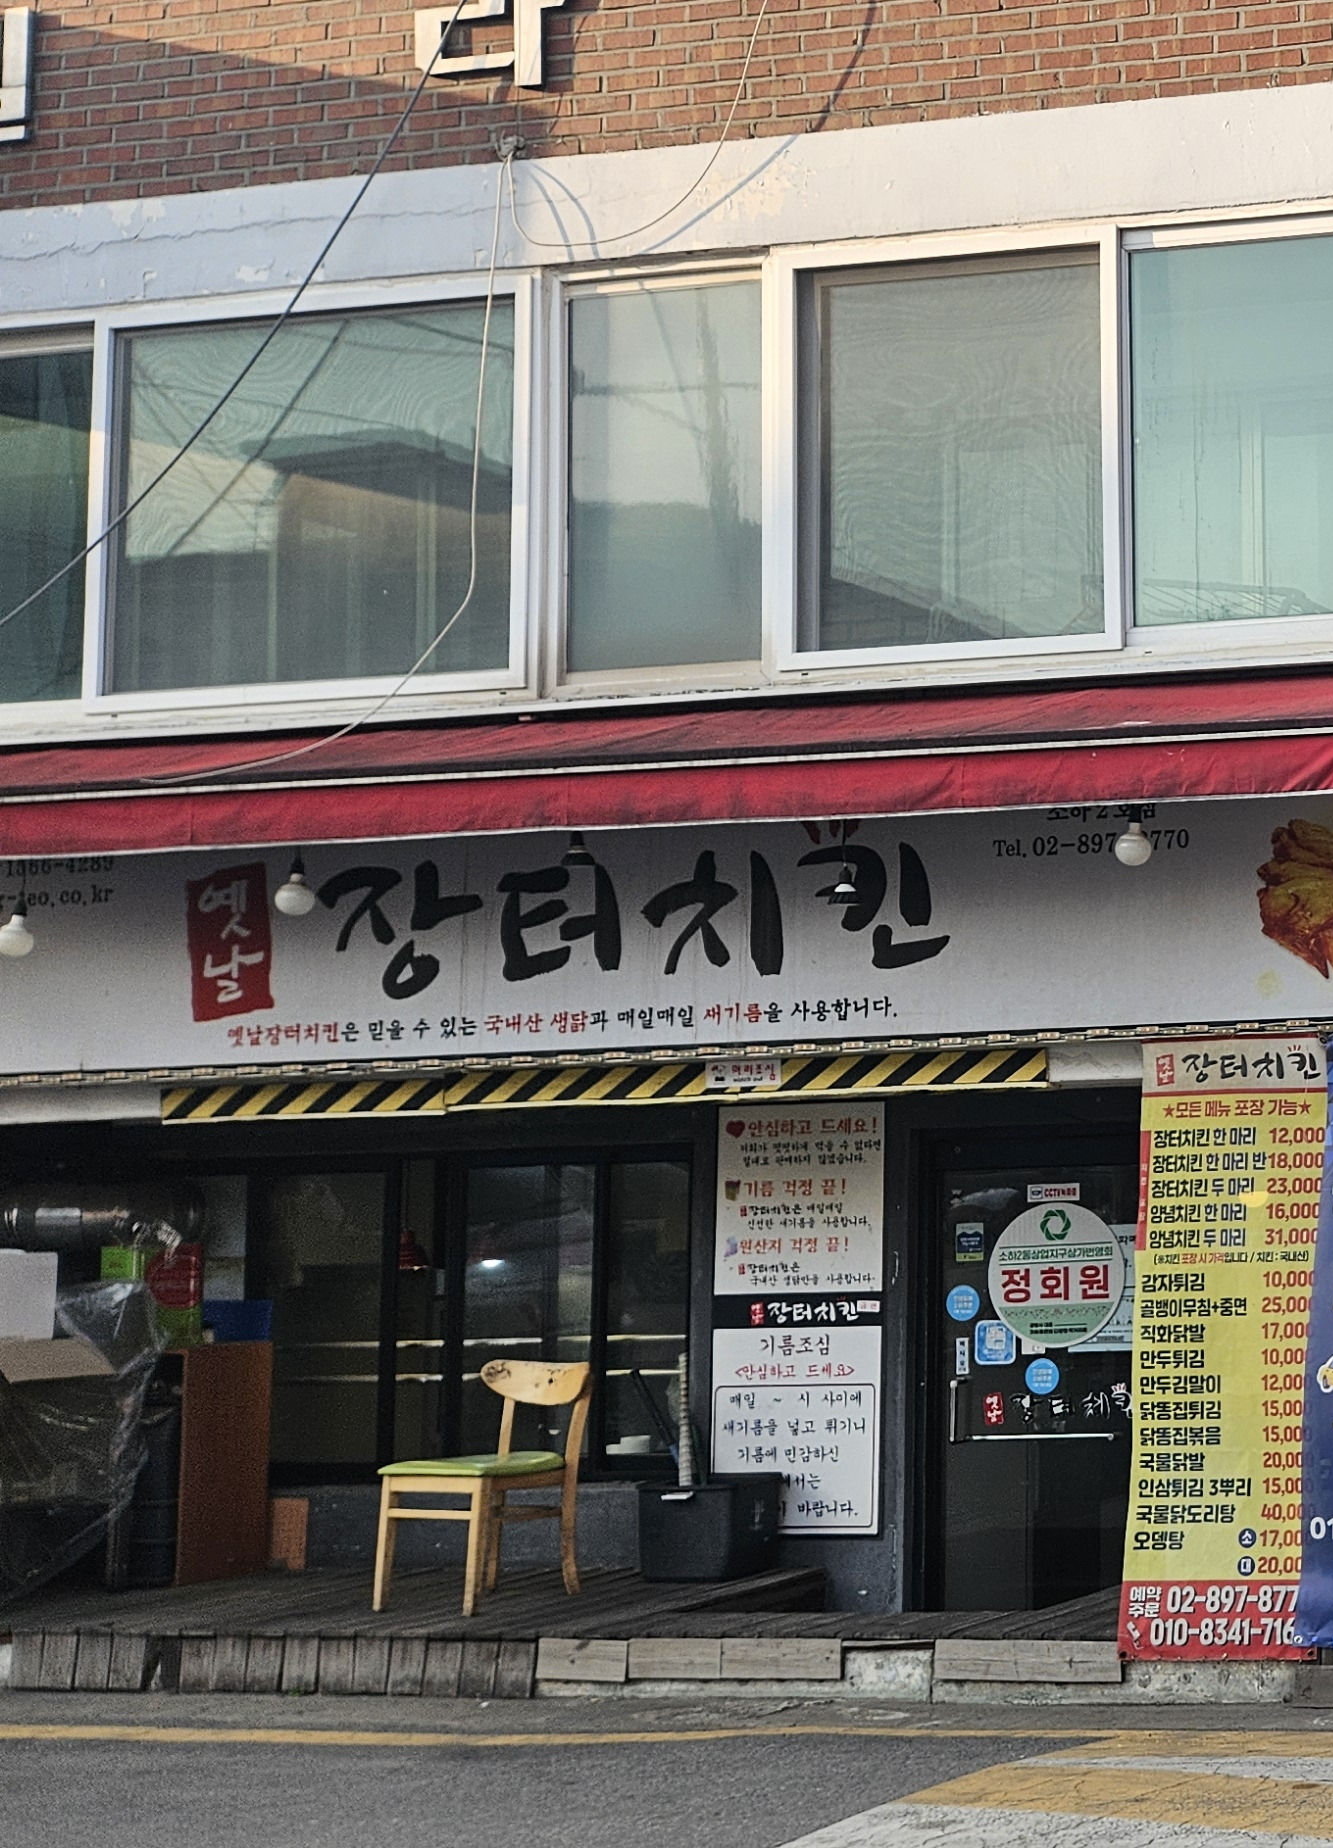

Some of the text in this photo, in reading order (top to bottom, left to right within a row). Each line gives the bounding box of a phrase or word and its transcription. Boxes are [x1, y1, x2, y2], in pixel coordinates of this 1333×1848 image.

[993, 829, 1190, 858] Tel. 02-897770
[316, 838, 950, 1000] 장터치킨
[369, 1019, 404, 1041] 믿을
[413, 1017, 431, 1039] 수
[440, 1016, 477, 1037] 있는
[484, 1012, 543, 1035] 국내산
[551, 1010, 608, 1033] 생닭과
[618, 1005, 694, 1030] 매일매일
[704, 1002, 782, 1026] 새기름을
[791, 996, 898, 1022] 사용합니다.
[1182, 1050, 1321, 1084] 장터치킨
[1176, 1099, 1297, 1118] 모든 메뉴 포장 가능
[748, 1117, 877, 1138] 안심하고 드세요!
[1154, 1127, 1325, 1148] 장터치킨 한 마리 12,000
[1152, 1152, 1324, 1173] 장터치킨 한 마리 반 18,000
[744, 1180, 774, 1197] 기름
[783, 1179, 812, 1196] 걱정
[1152, 1177, 1322, 1199] 장터치킨 두 마리 23,000
[1150, 1202, 1320, 1224] 양념치킨 한 마리 16,000
[739, 1238, 782, 1254] 원산지
[790, 1237, 818, 1253] 걱정
[1150, 1229, 1200, 1249] 양념치킨
[1203, 1229, 1216, 1247] 두
[1220, 1228, 1246, 1247] 마리
[1264, 1228, 1318, 1246] 31,000
[1181, 1252, 1197, 1264] 포장
[1256, 1251, 1274, 1262] 치킨
[1001, 1264, 1110, 1303] 정회원
[1141, 1273, 1205, 1293] 감자튀김
[767, 1302, 859, 1324] 장터치킨
[1140, 1298, 1247, 1318] 골뱅이무침+중면
[1140, 1324, 1206, 1343] 직화닭발
[760, 1333, 831, 1357] 기름조심
[1140, 1348, 1306, 1369] 만두튀김 10,00
[1140, 1374, 1305, 1395] 만두김말이 12,00
[729, 1393, 756, 1409] 매일
[821, 1390, 862, 1408] 사이에
[1140, 1400, 1304, 1420] 닭똥집튀김 15,00
[723, 1418, 866, 1436] 새기름을 넣고 튀기니
[1140, 1425, 1303, 1447] 닭똥집볶음 15,00
[737, 1446, 839, 1464] 기름에 민감하신
[1139, 1451, 1303, 1472] 국물닭발 20,00
[1138, 1477, 1302, 1498] 인삼튀김 3뿌리 15,00
[797, 1501, 859, 1518] 바랍니다.
[1136, 1503, 1302, 1525] 국물닭도리탕 40,00
[1133, 1530, 1302, 1551] 오뎅탕 소 17,00
[1240, 1556, 1301, 1576] 대 20,00
[1130, 1585, 1300, 1614] 예약 02-897-877
[1128, 1603, 1161, 1619] 주문
[1150, 1617, 1295, 1646] 010-8341-716
